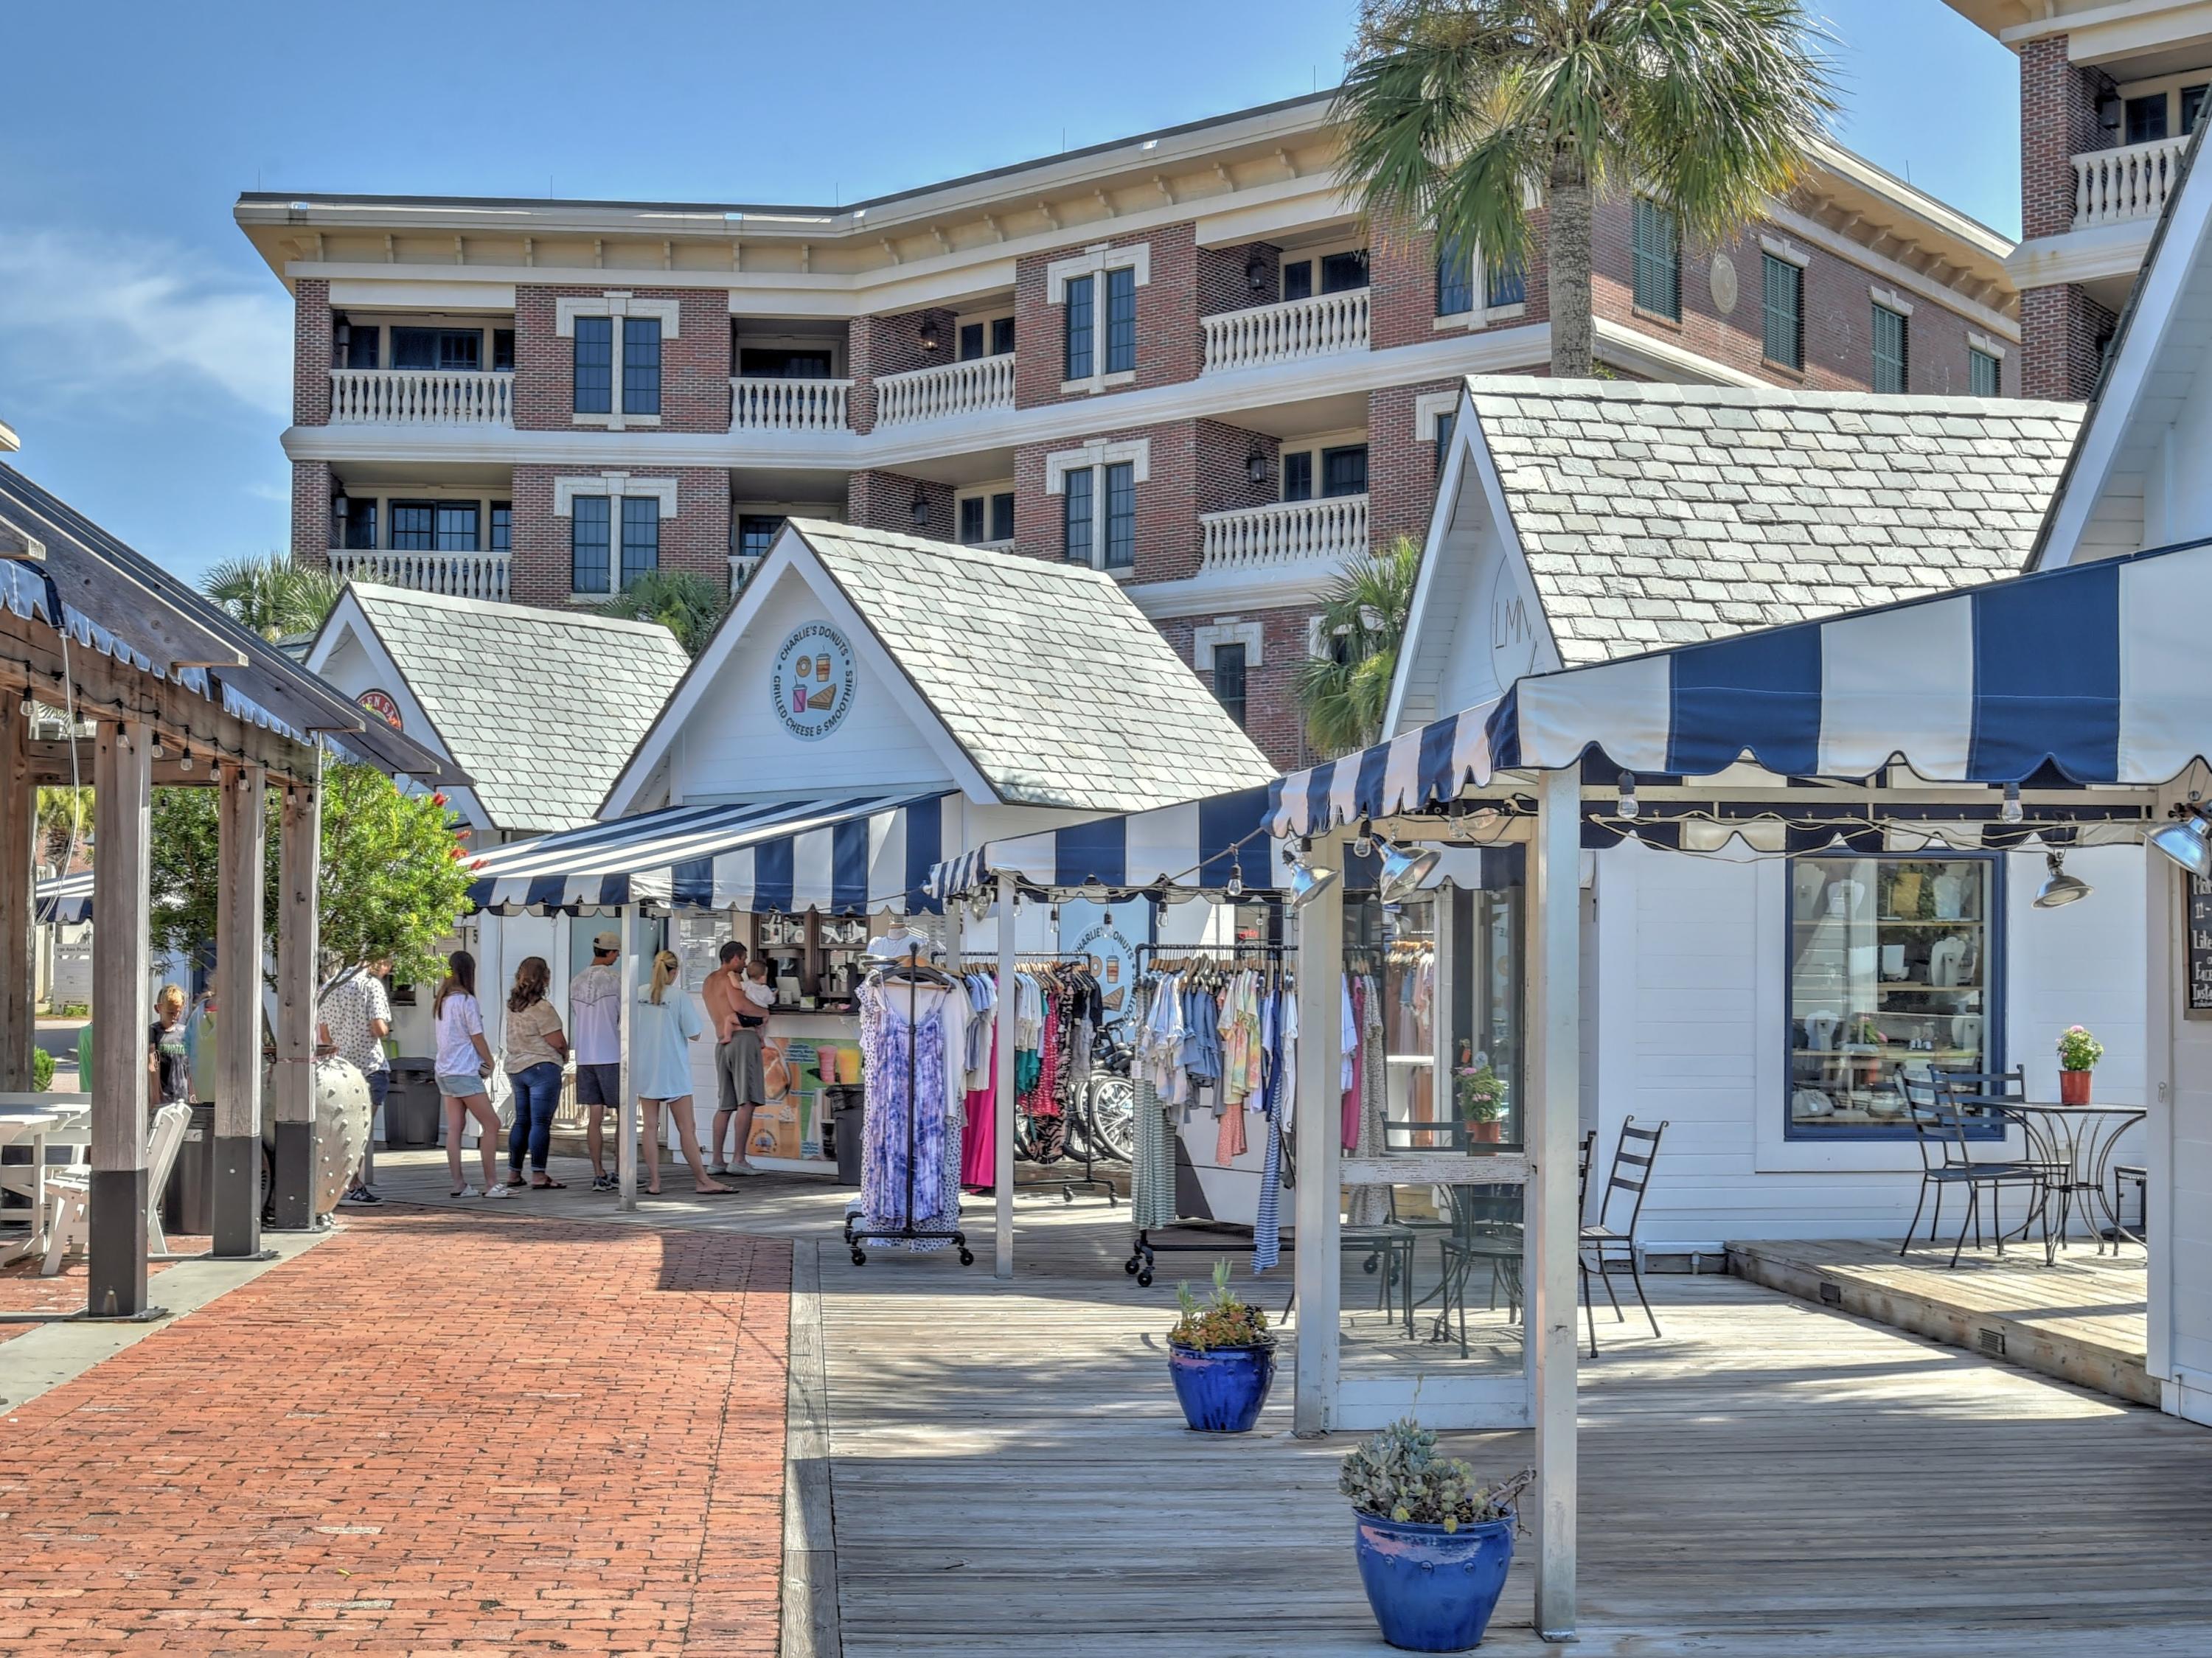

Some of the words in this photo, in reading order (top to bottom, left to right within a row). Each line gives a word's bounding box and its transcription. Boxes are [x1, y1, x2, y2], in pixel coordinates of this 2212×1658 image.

[780, 626, 818, 661] CHARLIE'S
[818, 626, 849, 656] DONUTS
[773, 675, 787, 719] GRILLED
[785, 717, 815, 736] CHEESE
[816, 725, 822, 735] &
[824, 670, 853, 731] SMOOTHIES
[473, 929, 478, 944] 5
[1074, 926, 1106, 959] HARLIE'
[1109, 930, 1135, 960] ONUTS
